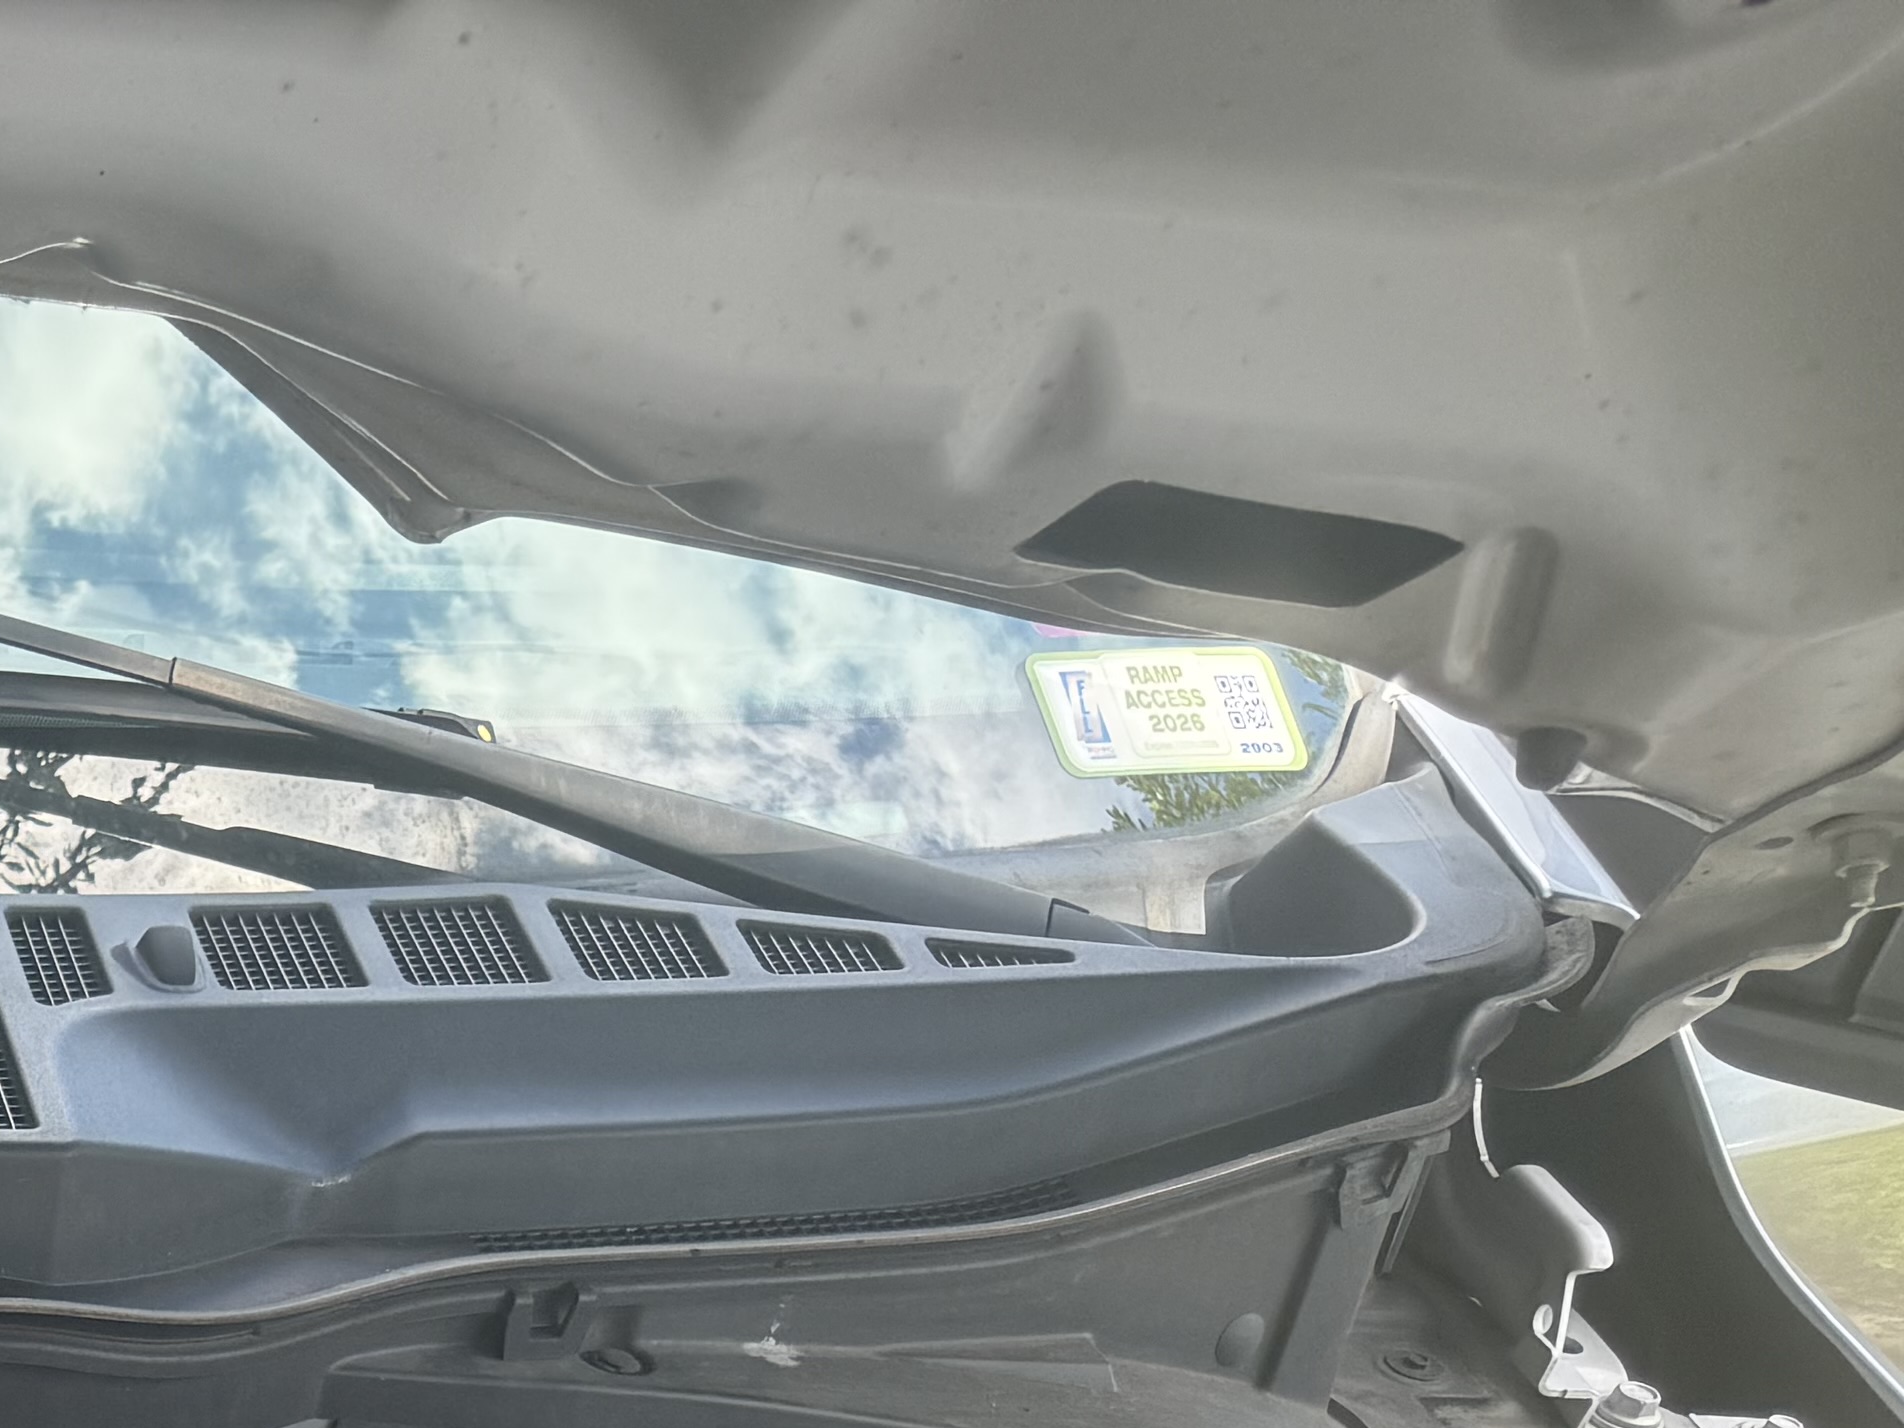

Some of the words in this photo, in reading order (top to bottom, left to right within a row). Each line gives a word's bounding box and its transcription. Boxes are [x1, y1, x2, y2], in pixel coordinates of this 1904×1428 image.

[1126, 665, 1183, 684] RAMP
[1124, 690, 1206, 709] ACCESS
[1149, 714, 1205, 732] 2026
